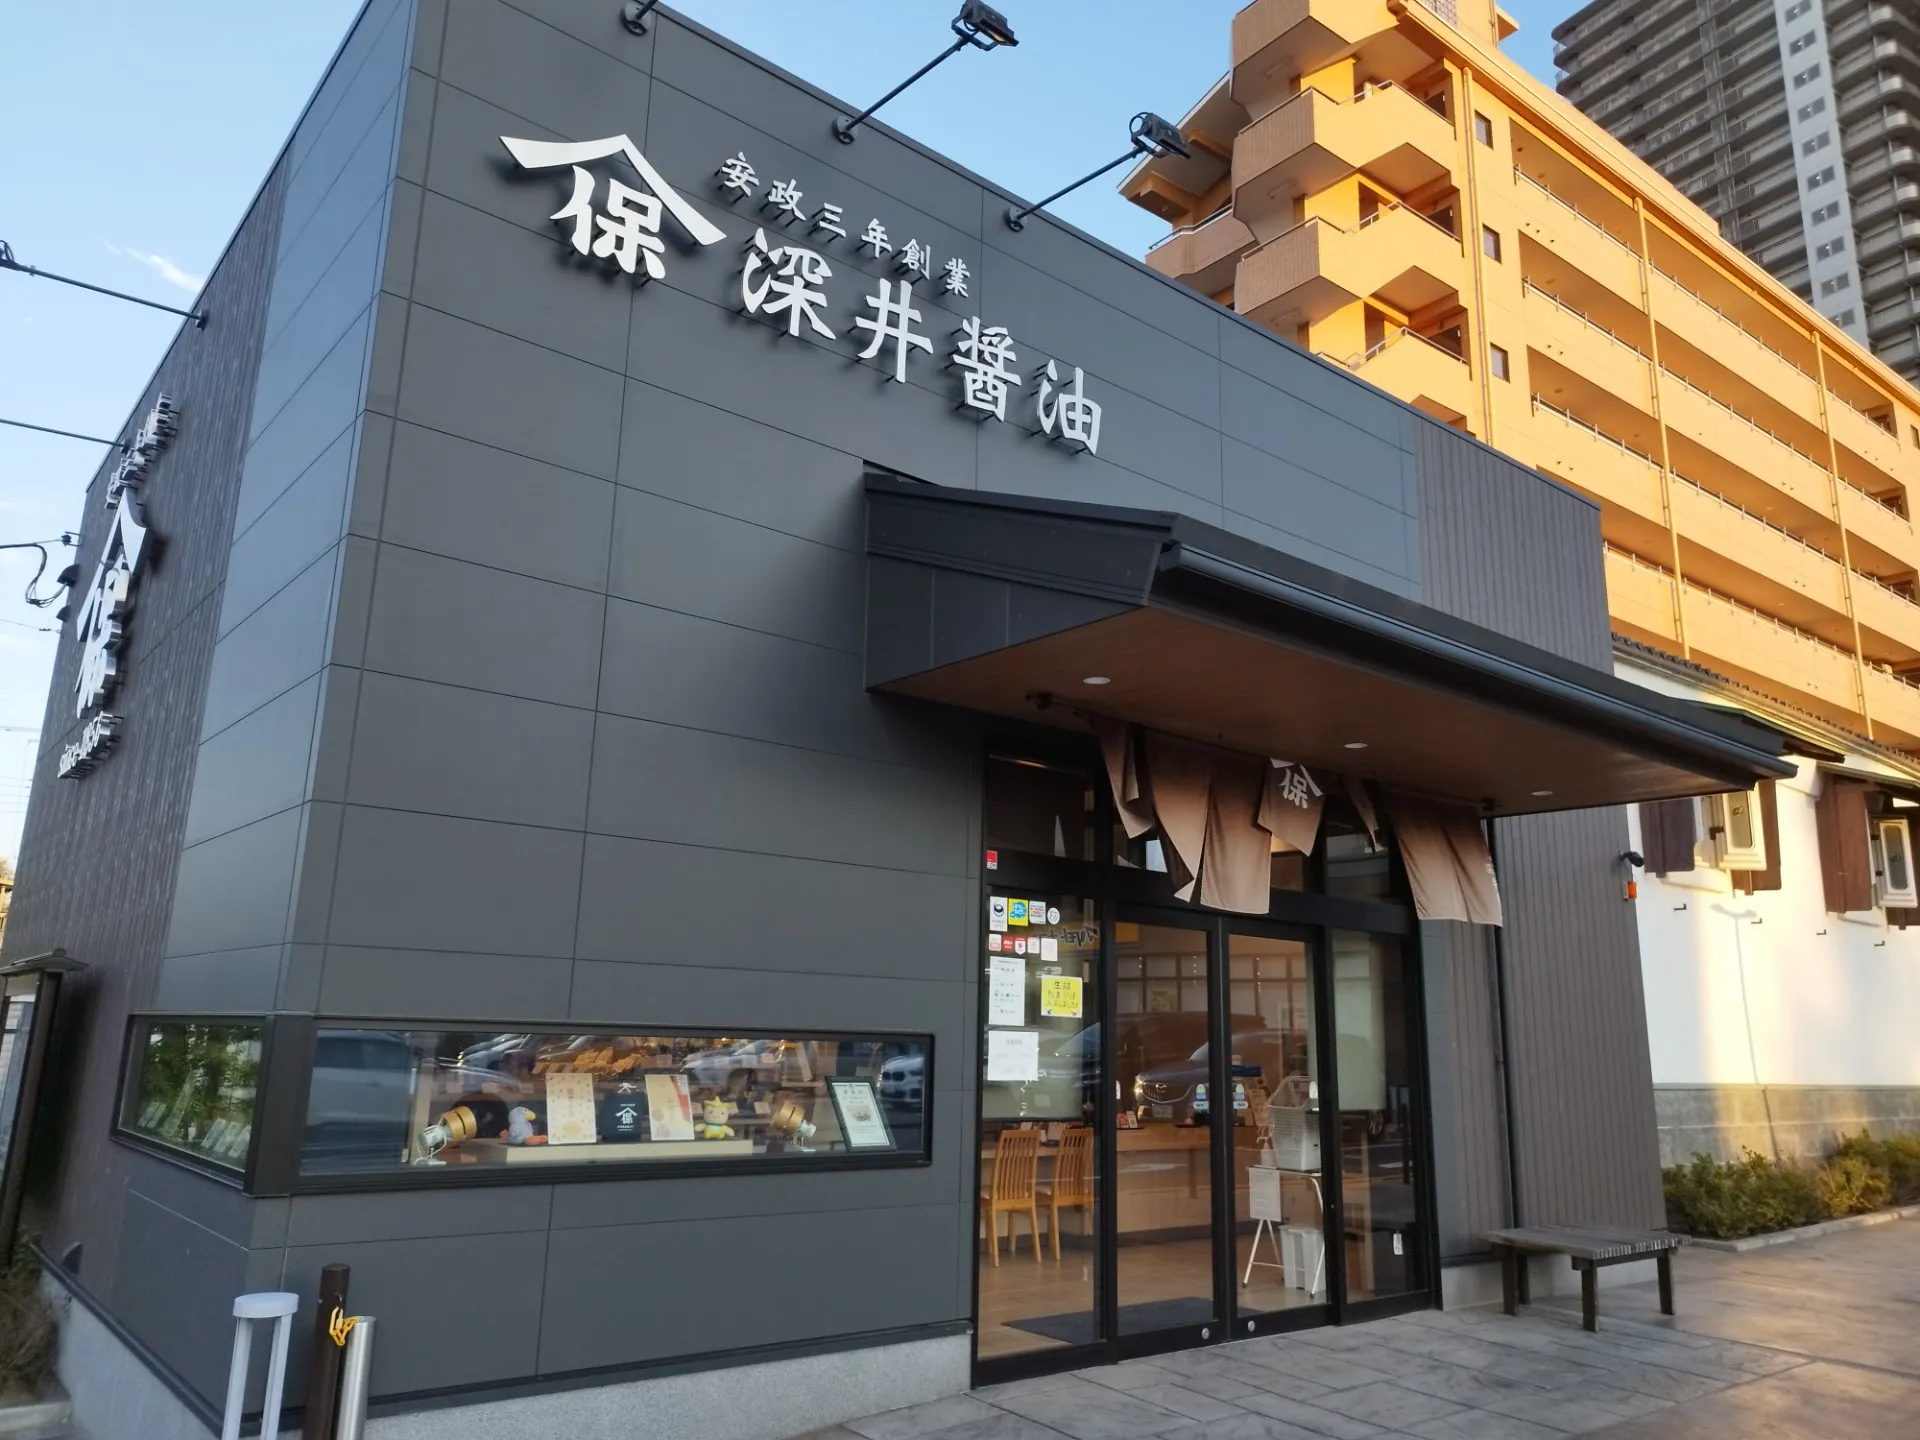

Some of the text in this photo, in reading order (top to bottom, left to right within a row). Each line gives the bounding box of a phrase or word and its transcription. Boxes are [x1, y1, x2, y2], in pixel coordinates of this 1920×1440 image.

[720, 151, 970, 298] 安政三年創業
[741, 227, 1102, 456] 深井醤油
